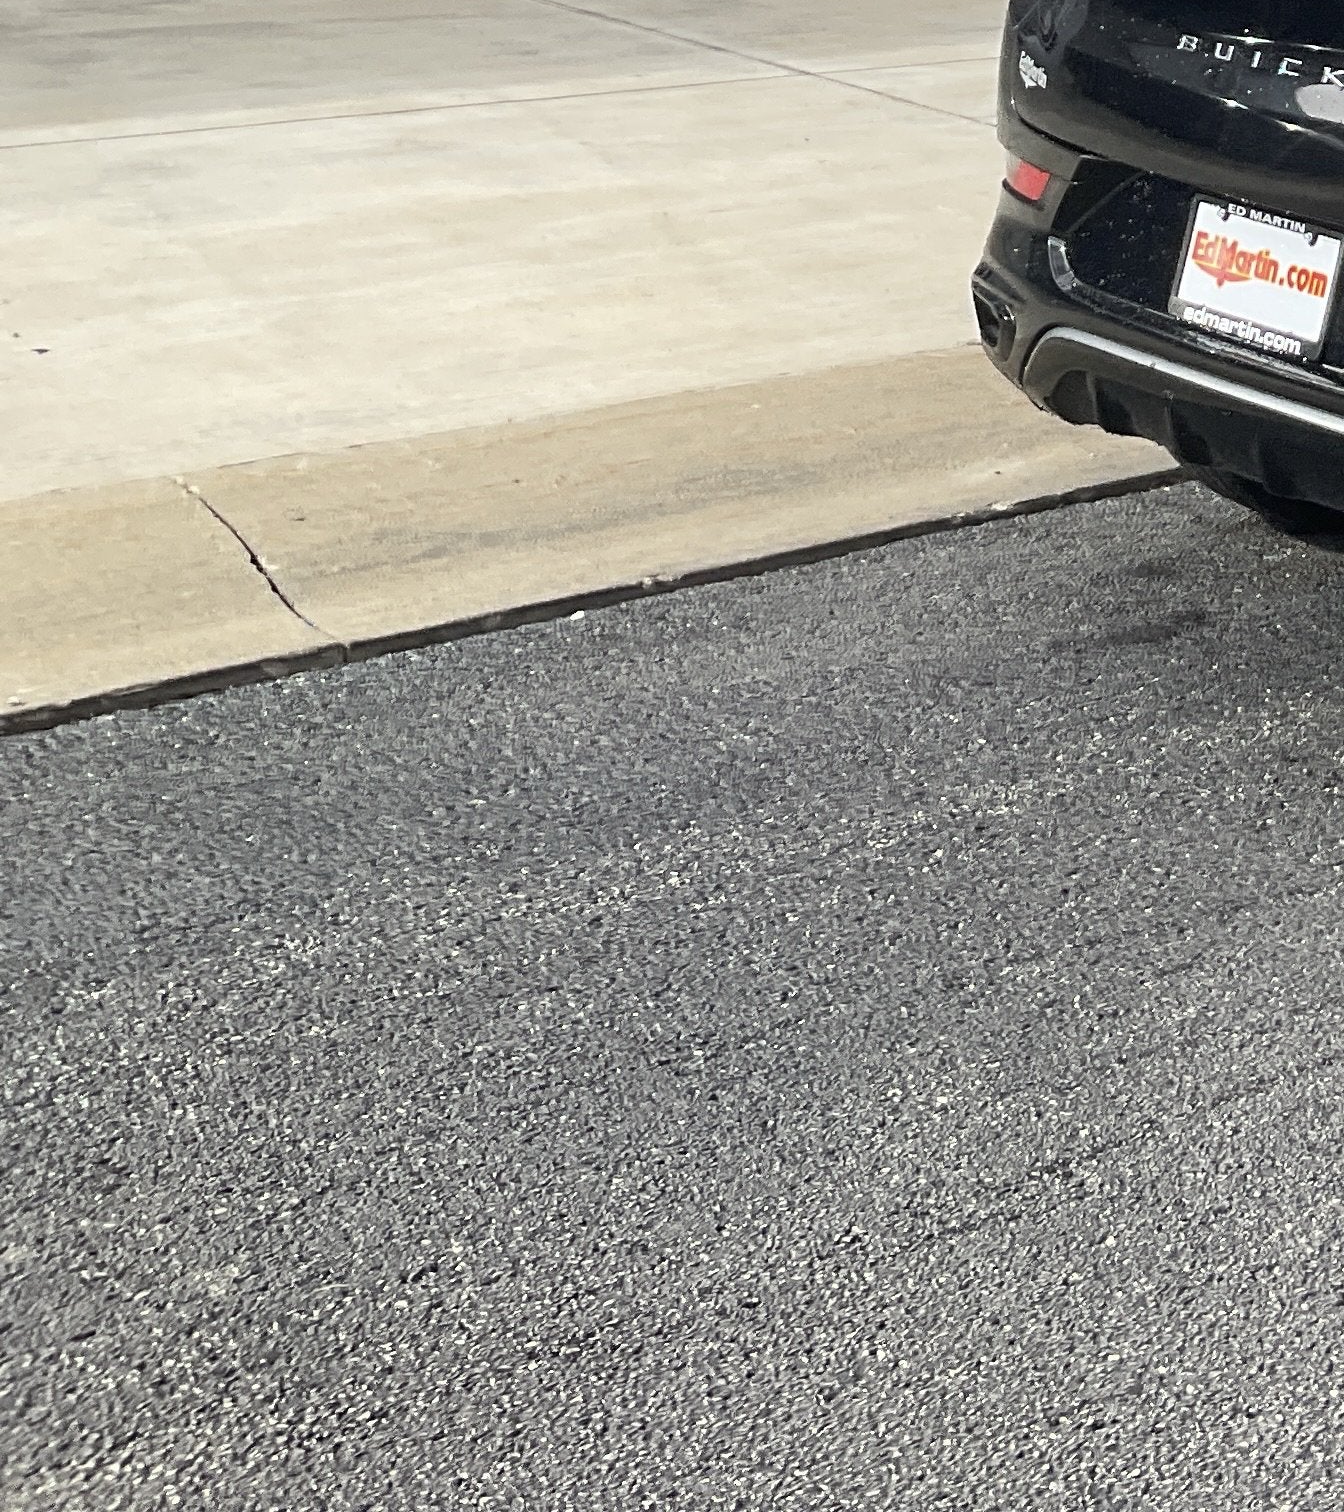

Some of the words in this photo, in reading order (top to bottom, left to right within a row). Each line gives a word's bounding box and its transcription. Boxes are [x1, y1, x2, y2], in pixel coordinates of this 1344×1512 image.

[1227, 202, 1248, 217] ED
[1249, 209, 1307, 234] MARTIN
[1183, 305, 1301, 355] edmartin.com
